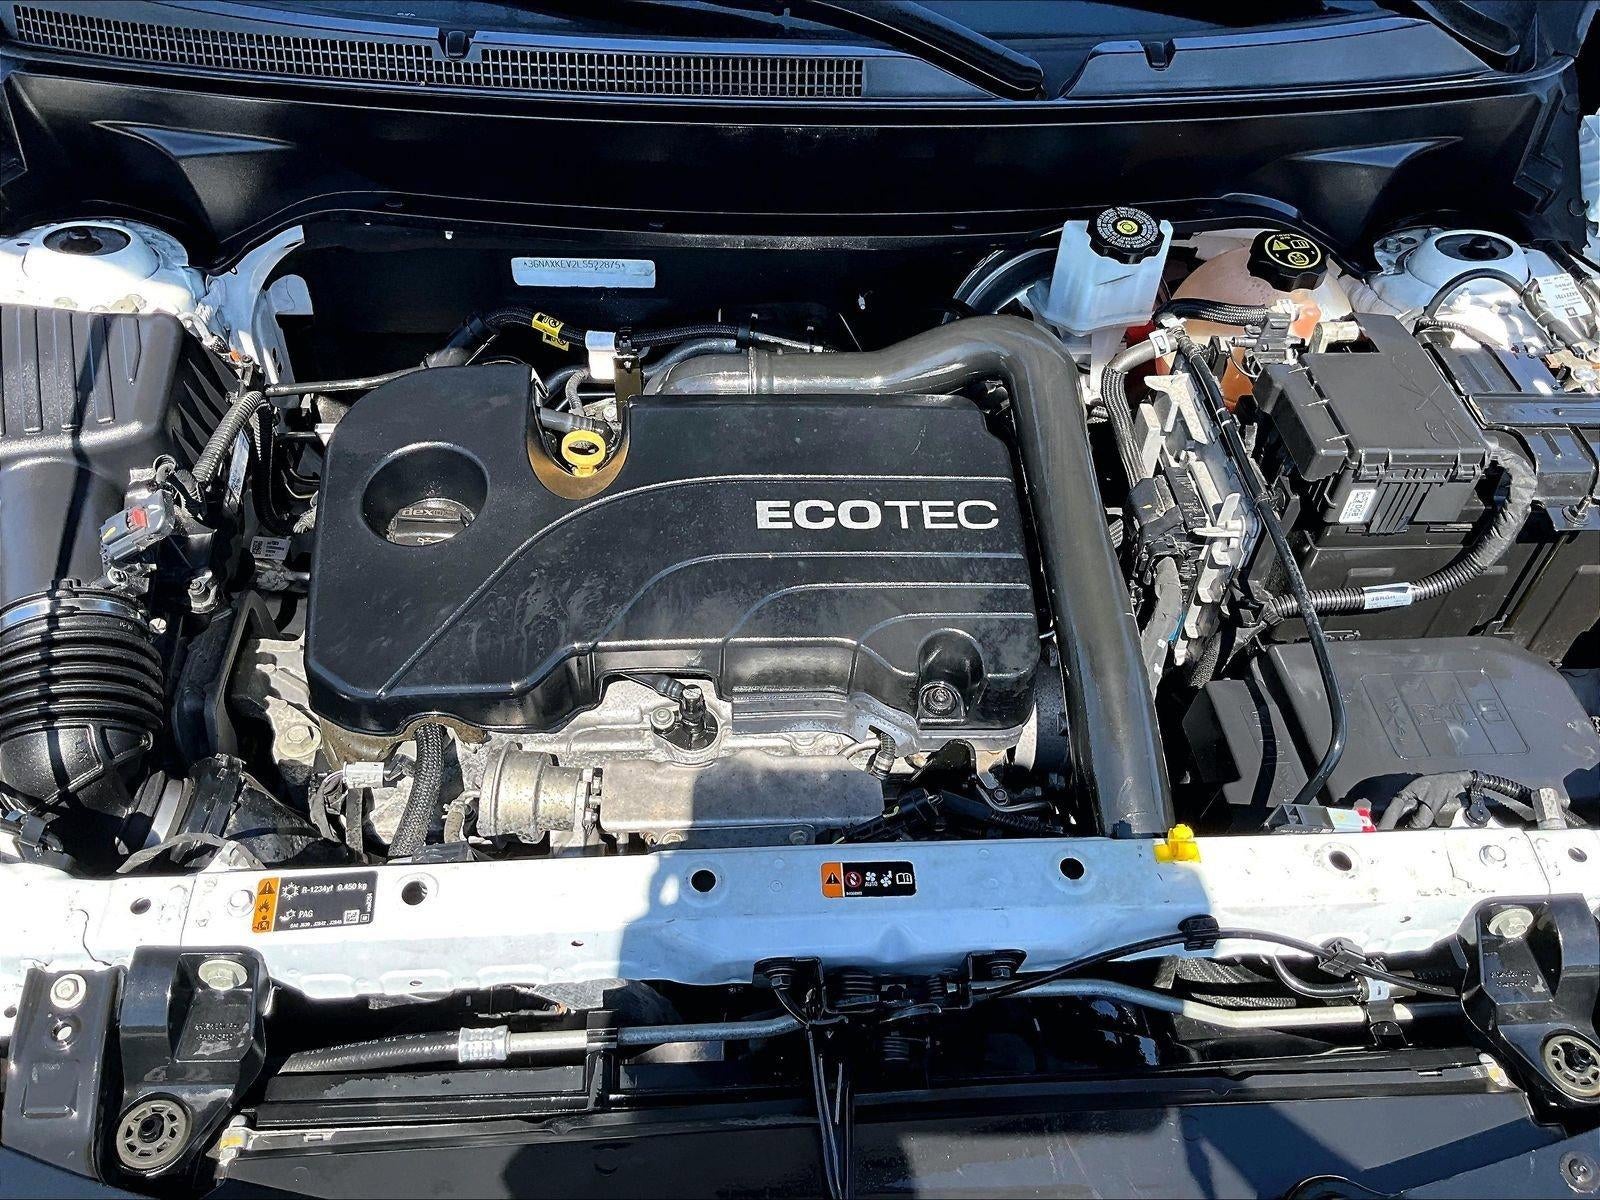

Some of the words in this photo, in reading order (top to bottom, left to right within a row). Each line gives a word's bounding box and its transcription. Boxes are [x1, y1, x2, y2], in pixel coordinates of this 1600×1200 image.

[755, 500, 999, 530] ECOTEC
[302, 885, 333, 893] R-1234yf
[337, 883, 356, 891] 0.450
[357, 882, 367, 890] kg
[298, 910, 314, 918] PAG
